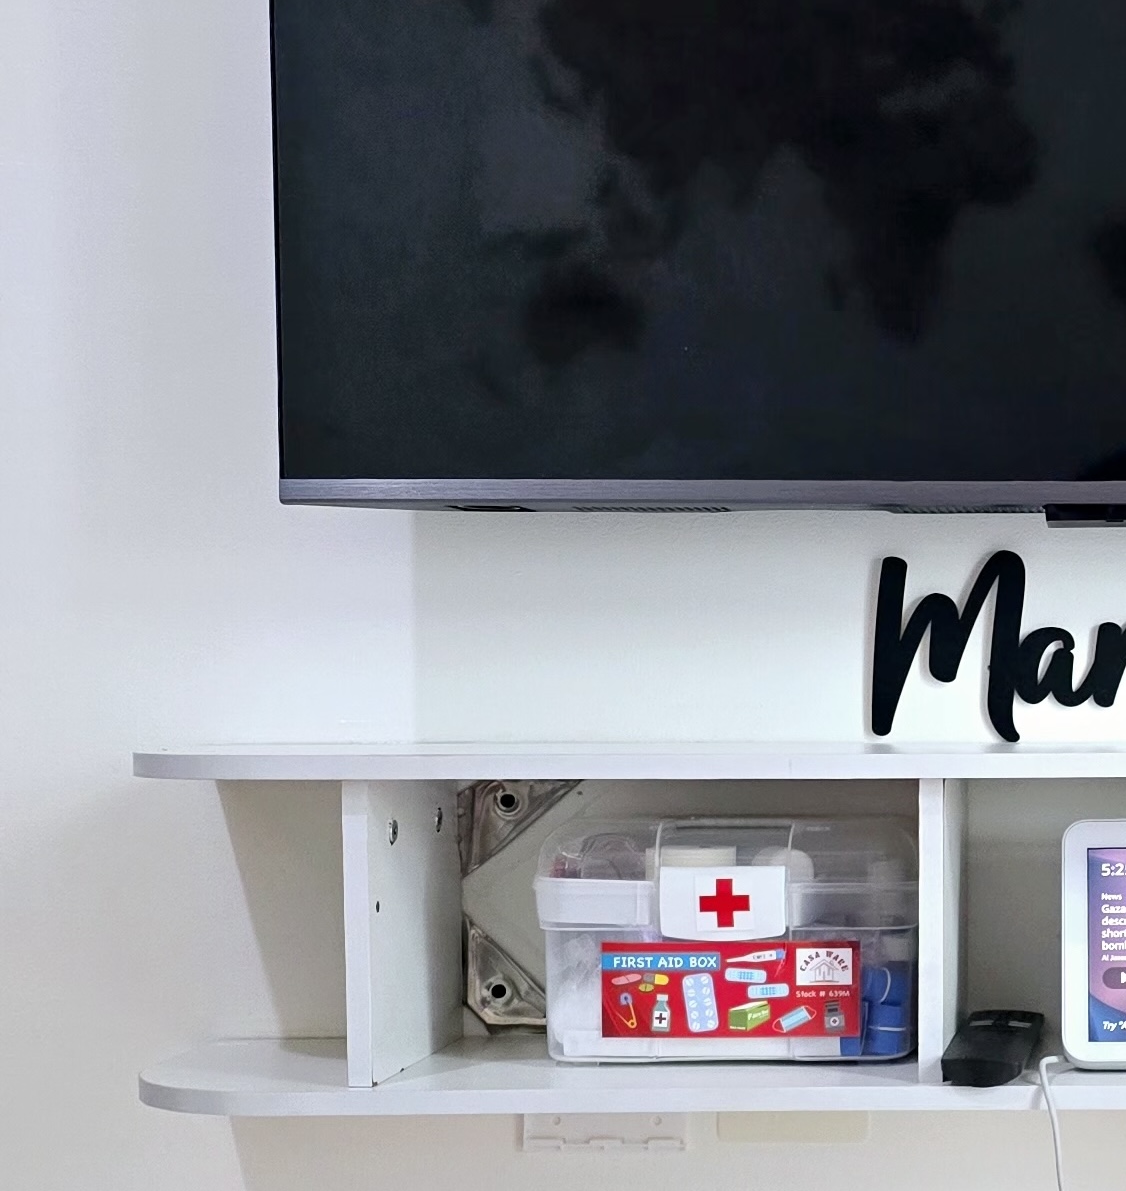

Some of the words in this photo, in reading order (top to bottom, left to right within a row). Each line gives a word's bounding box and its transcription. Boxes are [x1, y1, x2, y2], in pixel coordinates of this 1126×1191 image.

[1101, 893, 1123, 901] News
[1101, 904, 1126, 914] Gaza
[613, 956, 653, 968] FIRST
[657, 956, 684, 968] AID
[689, 956, 718, 968] BOX
[799, 951, 821, 972] CASA
[795, 990, 817, 998] Stock
[819, 990, 826, 998] #
[1102, 1020, 1118, 1032] Try
